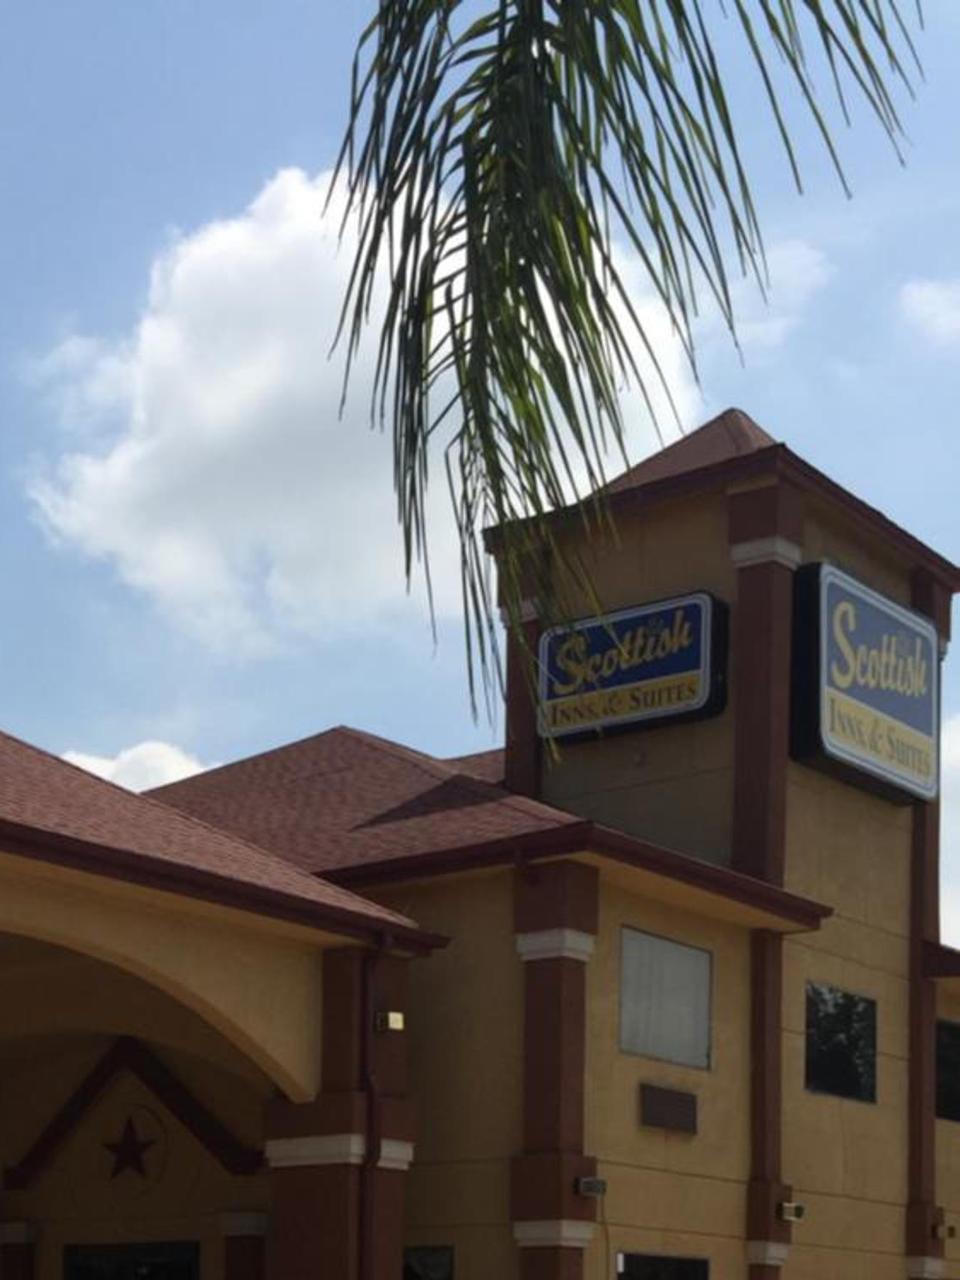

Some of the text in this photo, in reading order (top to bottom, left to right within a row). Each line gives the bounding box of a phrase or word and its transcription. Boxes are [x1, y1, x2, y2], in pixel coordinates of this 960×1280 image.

[553, 609, 693, 694] Scottish
[831, 601, 928, 696] Scottish
[551, 703, 596, 726] INNS
[629, 684, 697, 709] SUITES
[886, 726, 930, 776] SUITES
